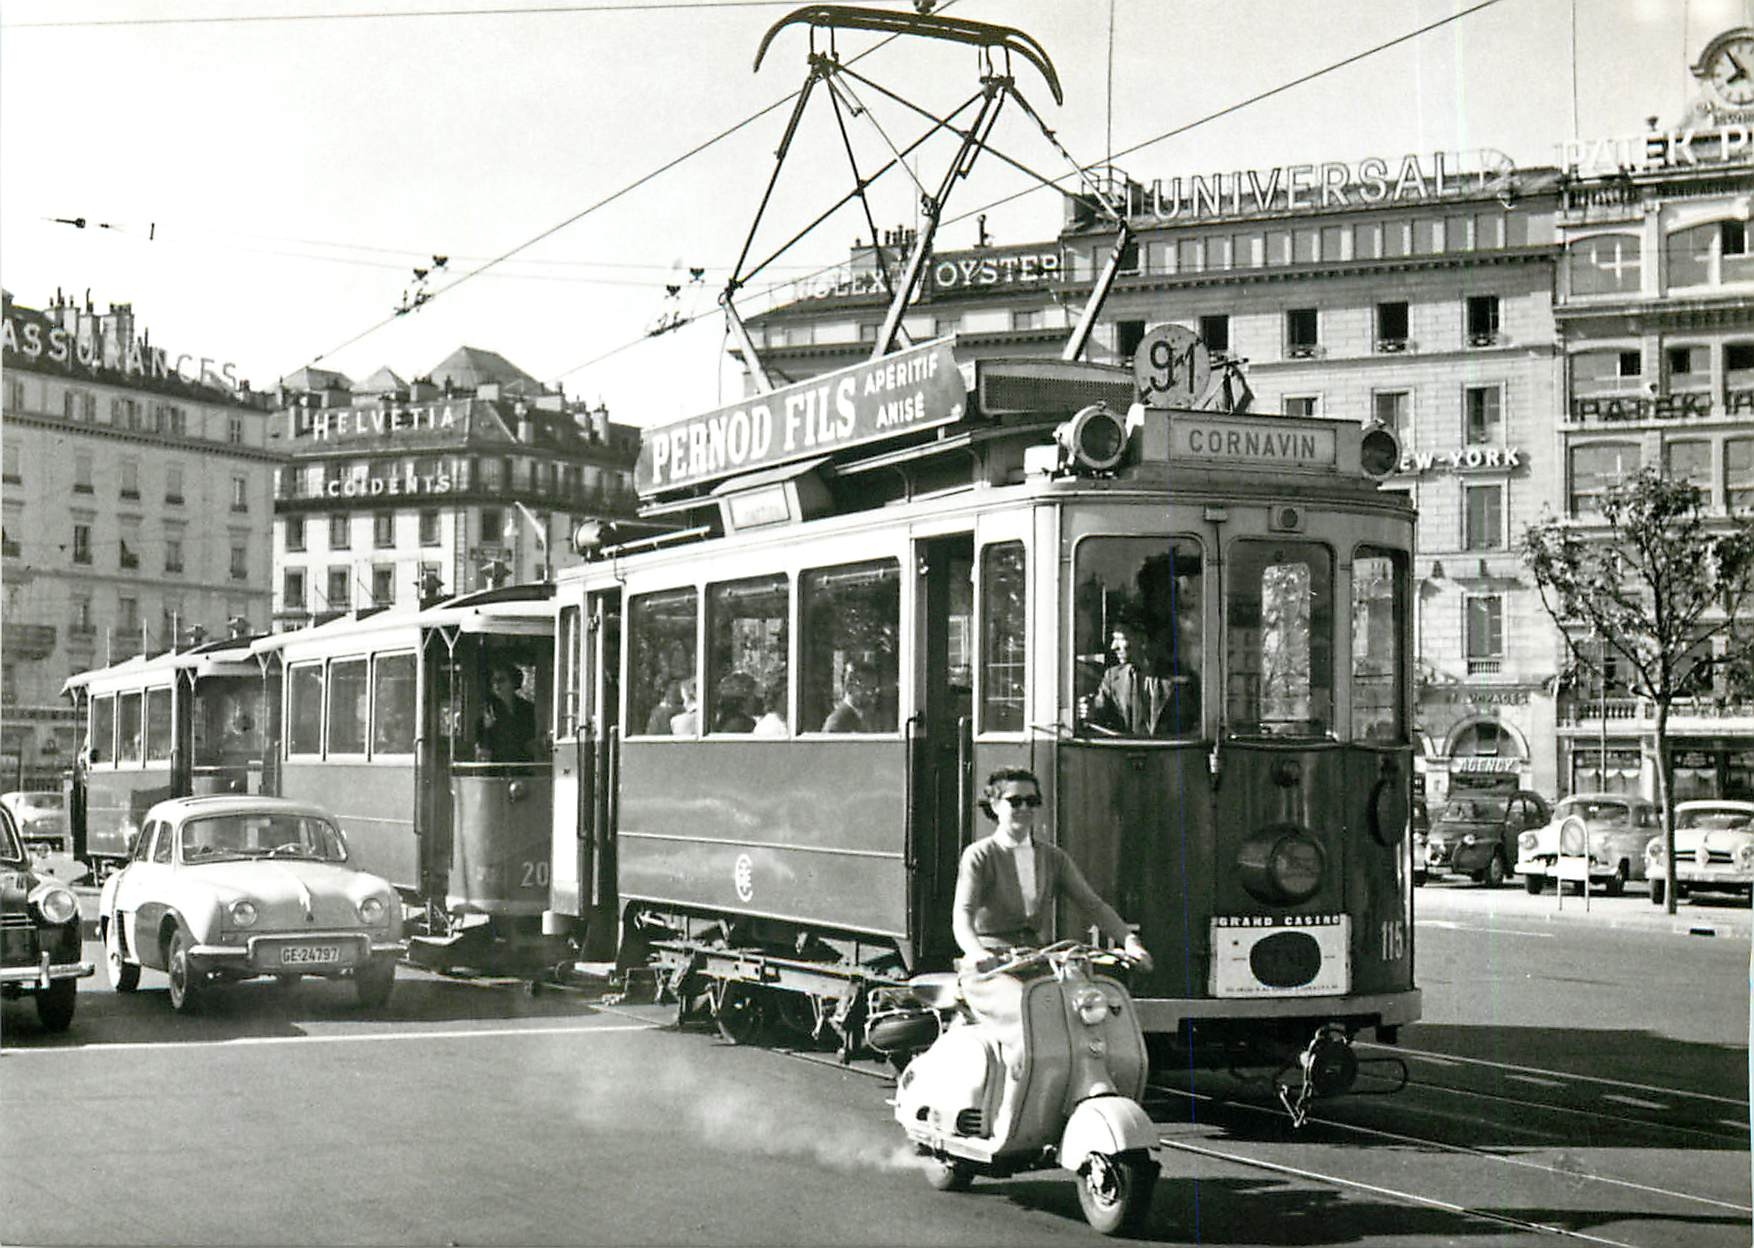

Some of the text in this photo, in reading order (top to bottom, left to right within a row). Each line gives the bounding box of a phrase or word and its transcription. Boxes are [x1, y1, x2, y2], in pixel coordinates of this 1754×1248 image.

[936, 254, 1060, 288] OYSTER
[314, 406, 454, 440] HELVETIA
[651, 404, 772, 484] PERNOD
[784, 376, 857, 451] FILS
[1189, 429, 1316, 459] CORNAVIN
[1400, 446, 1520, 470] EW-YORK
[1219, 916, 1273, 926] GRAND
